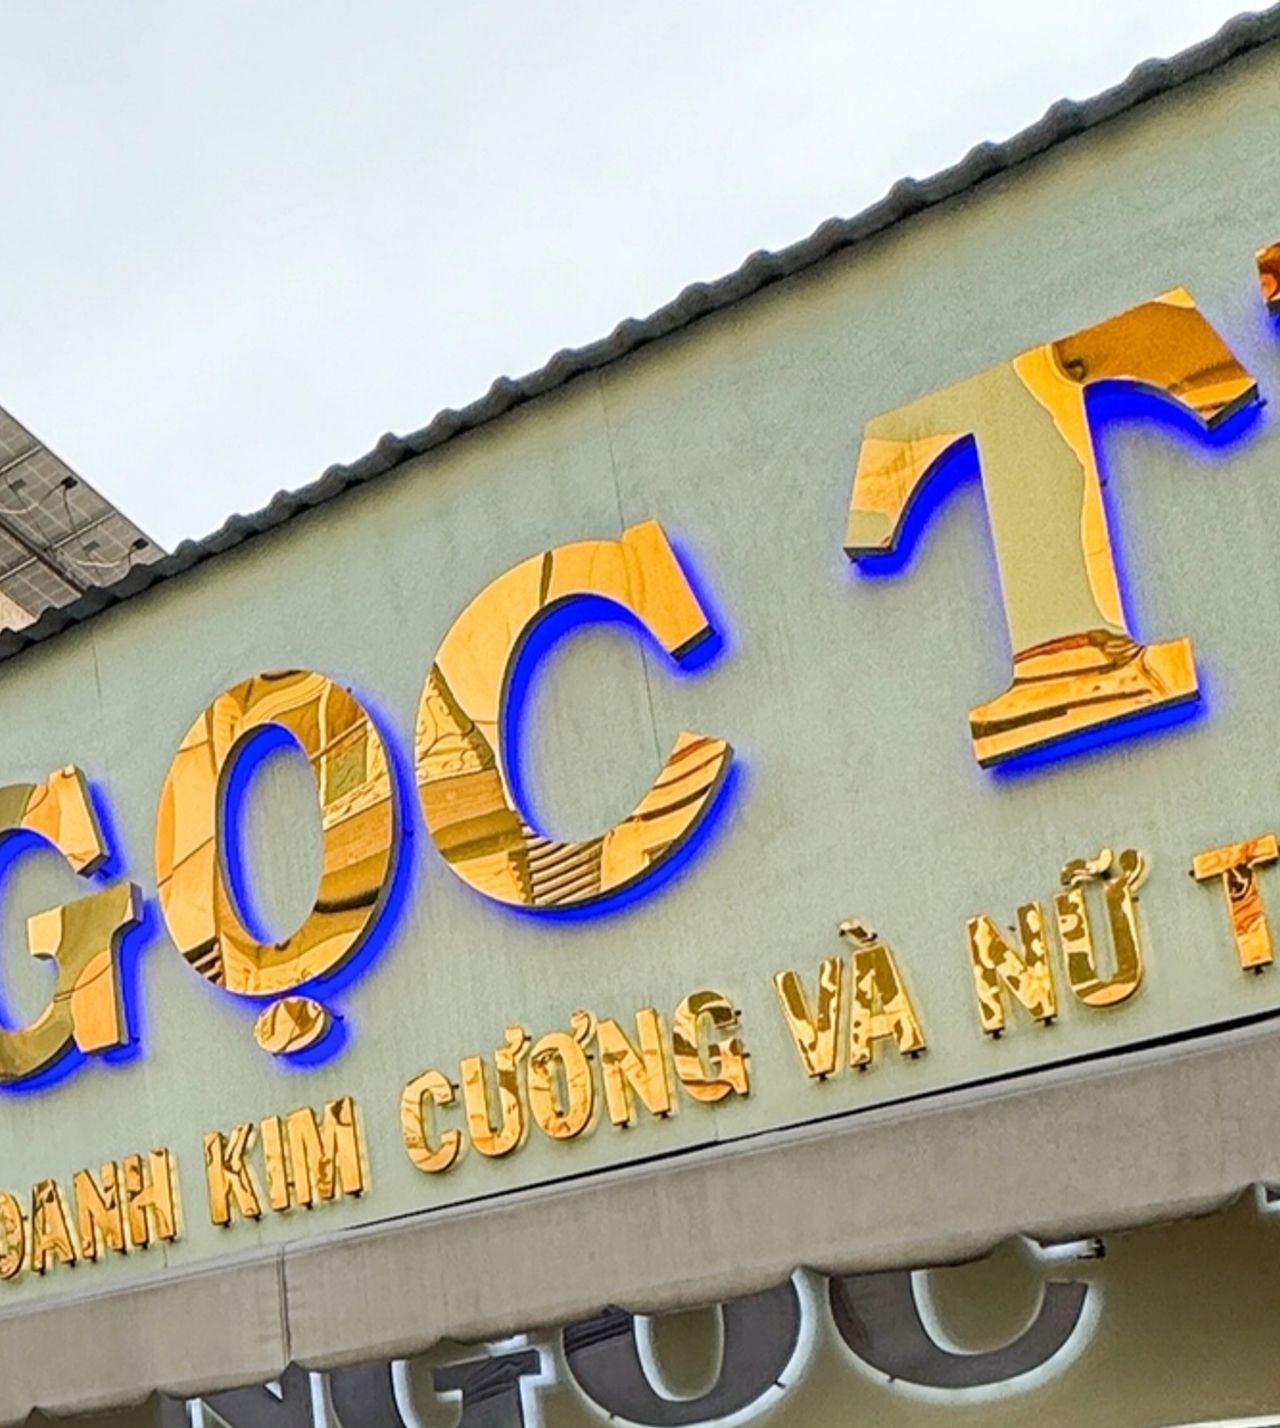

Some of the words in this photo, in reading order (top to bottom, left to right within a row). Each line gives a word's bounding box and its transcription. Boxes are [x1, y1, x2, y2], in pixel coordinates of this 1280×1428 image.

[843, 243, 1280, 768] T
[205, 1096, 366, 1227] KIM
[401, 989, 751, 1176] CƯƠNG
[773, 918, 927, 1081] VÀ
[966, 847, 1148, 1037] NỮ
